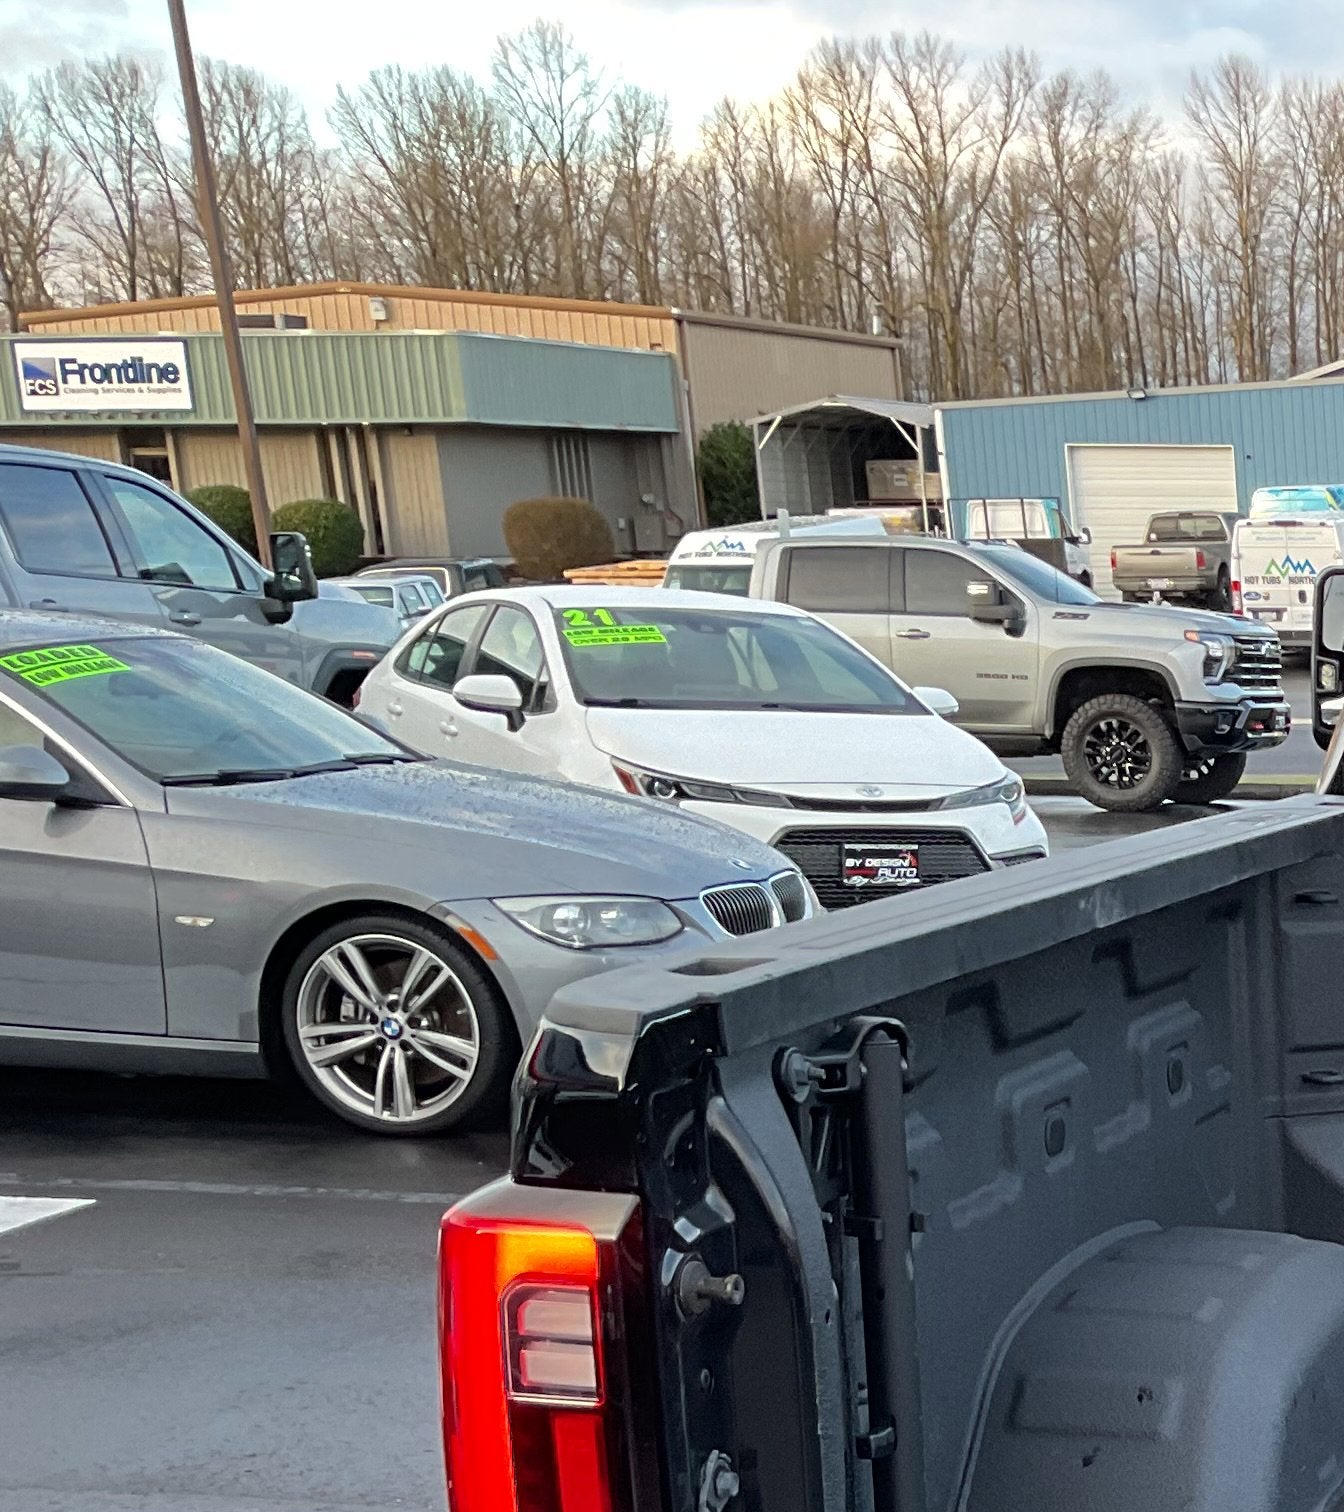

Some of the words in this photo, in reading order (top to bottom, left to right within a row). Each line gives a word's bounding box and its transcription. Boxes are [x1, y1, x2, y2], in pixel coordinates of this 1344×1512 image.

[59, 356, 180, 384] Frontline
[26, 380, 57, 395] FCS
[64, 386, 99, 395] Cleaning
[102, 386, 135, 394] Services
[147, 386, 182, 395] Supplies
[1245, 576, 1259, 584] HOT
[1261, 576, 1281, 584] TUBS
[1289, 576, 1315, 584] NORTH
[562, 608, 615, 626] 21
[4, 647, 100, 669] LOADED
[845, 858, 862, 867] BY
[865, 858, 910, 867] DESIGN
[878, 867, 917, 878] AUTO
